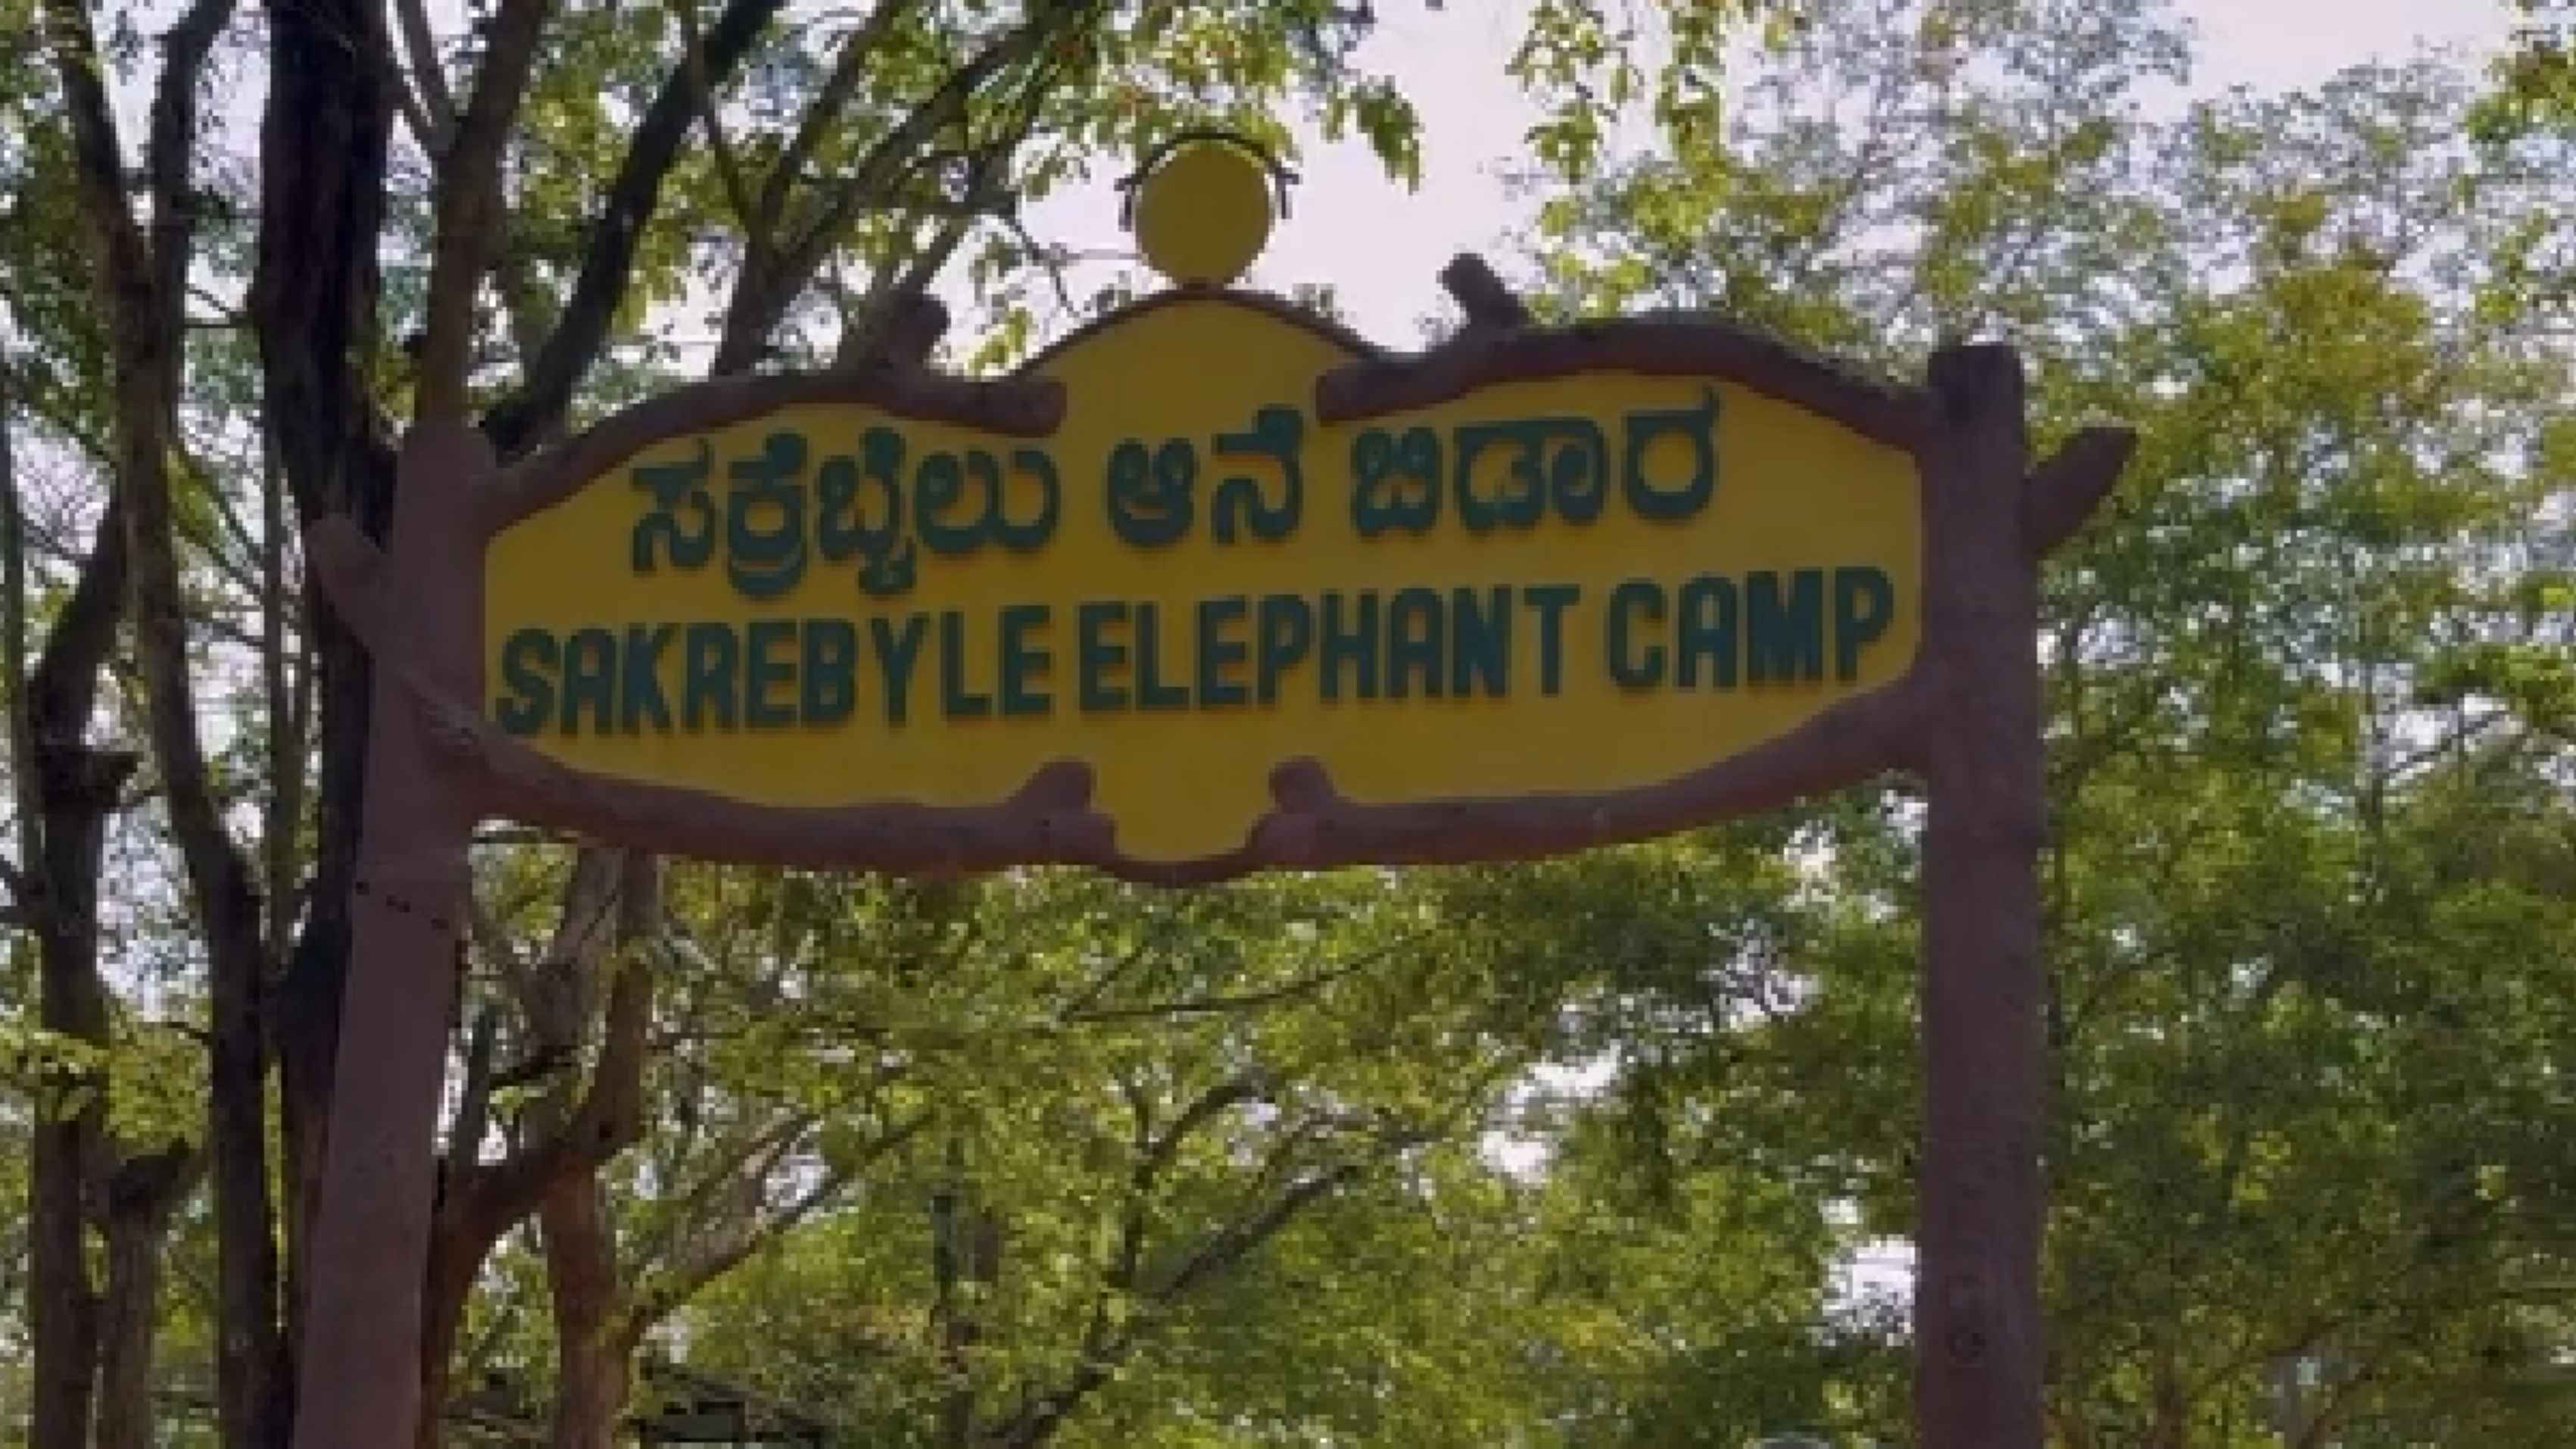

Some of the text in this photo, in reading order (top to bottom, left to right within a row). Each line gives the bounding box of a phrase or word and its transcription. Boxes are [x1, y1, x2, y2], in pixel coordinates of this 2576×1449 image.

[1106, 404, 1305, 547] ಆನೆ
[1350, 386, 1719, 536] ಬಿಡಾರ
[495, 565, 1895, 738] SAKREBYLE ELEPHANT CAMP
